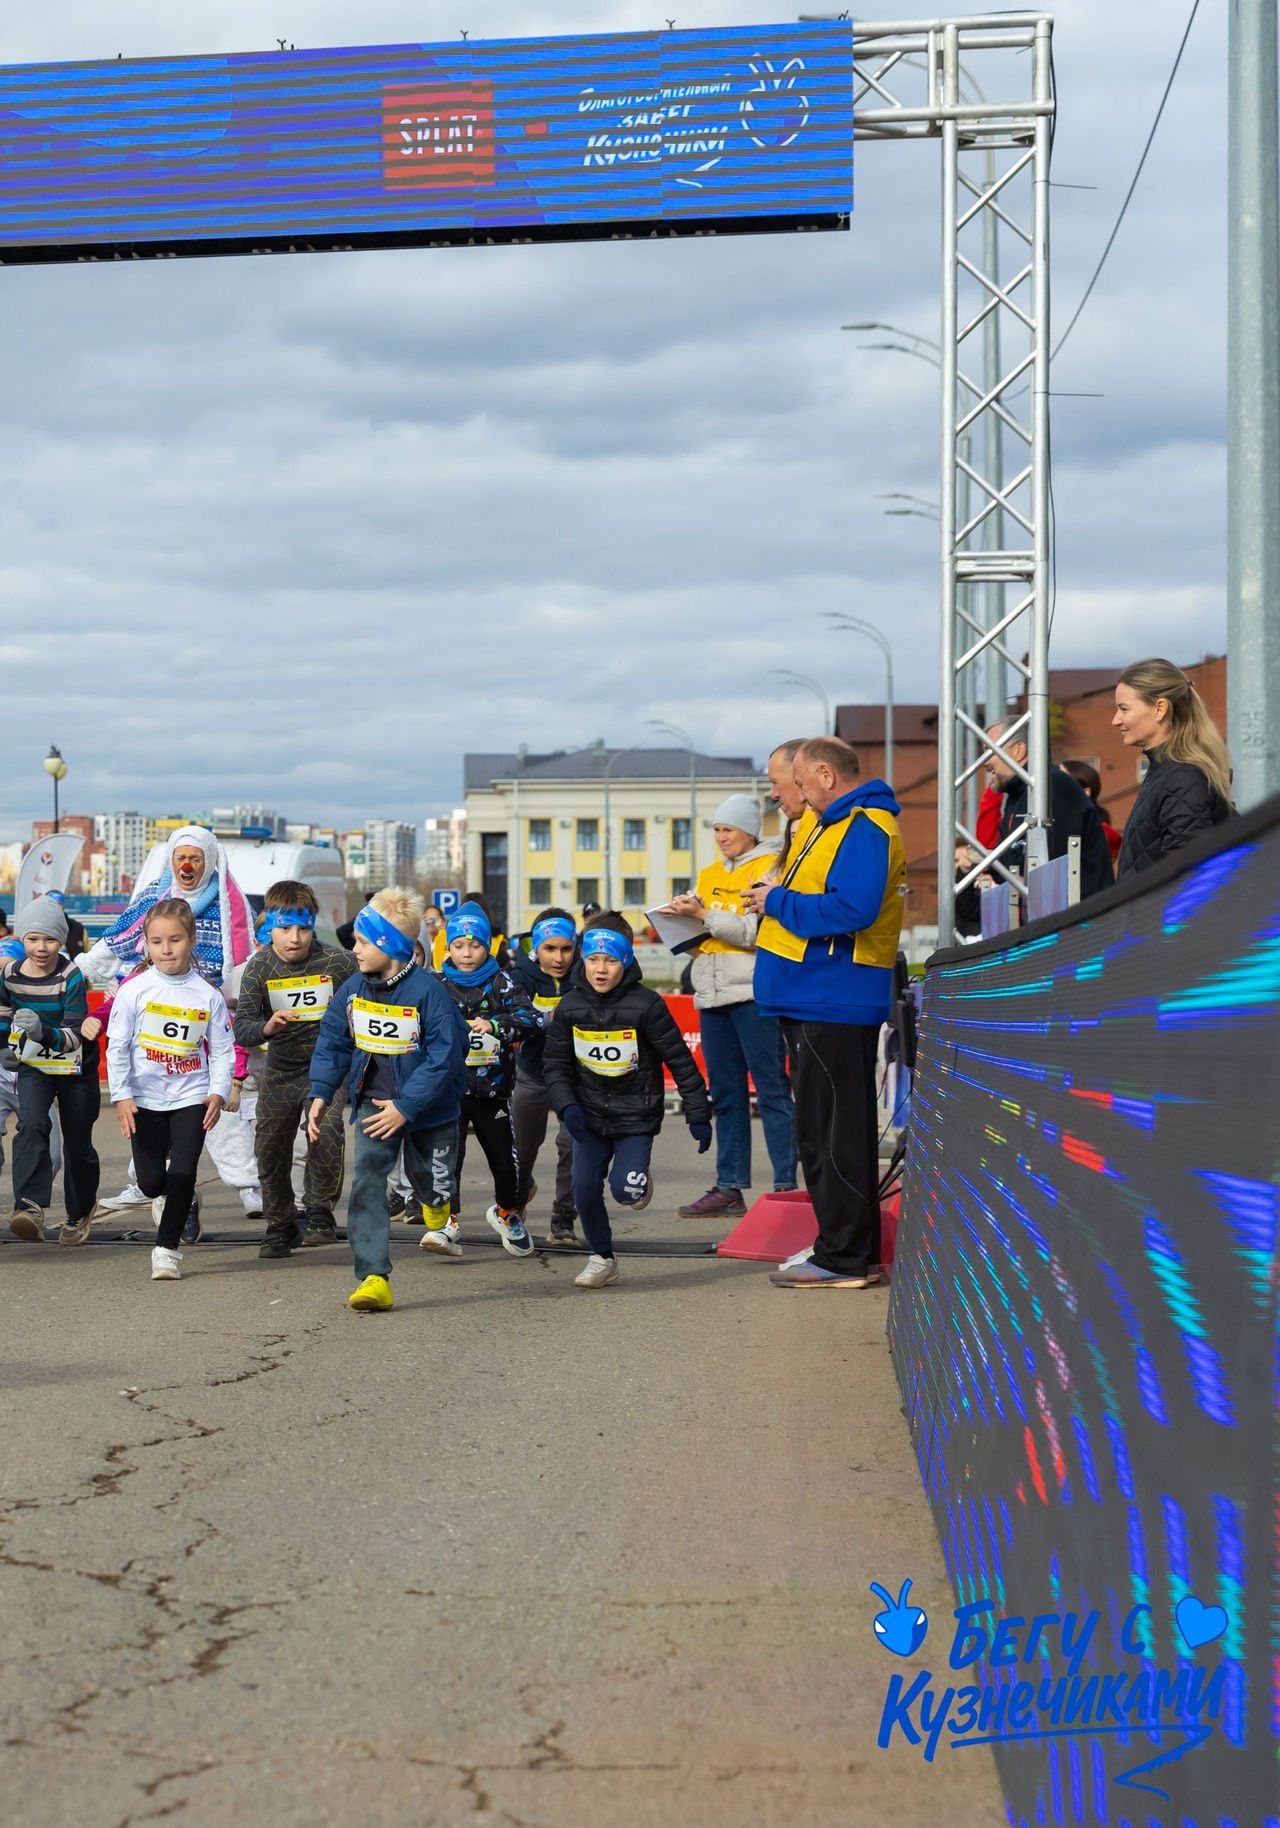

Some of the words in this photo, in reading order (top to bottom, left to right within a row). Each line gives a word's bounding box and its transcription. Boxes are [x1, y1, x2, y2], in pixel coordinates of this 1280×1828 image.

[400, 115, 477, 155] SPLAT
[287, 991, 317, 1007] 75
[162, 1022, 190, 1040] 61
[368, 1019, 399, 1038] 52
[588, 1046, 621, 1062] 40
